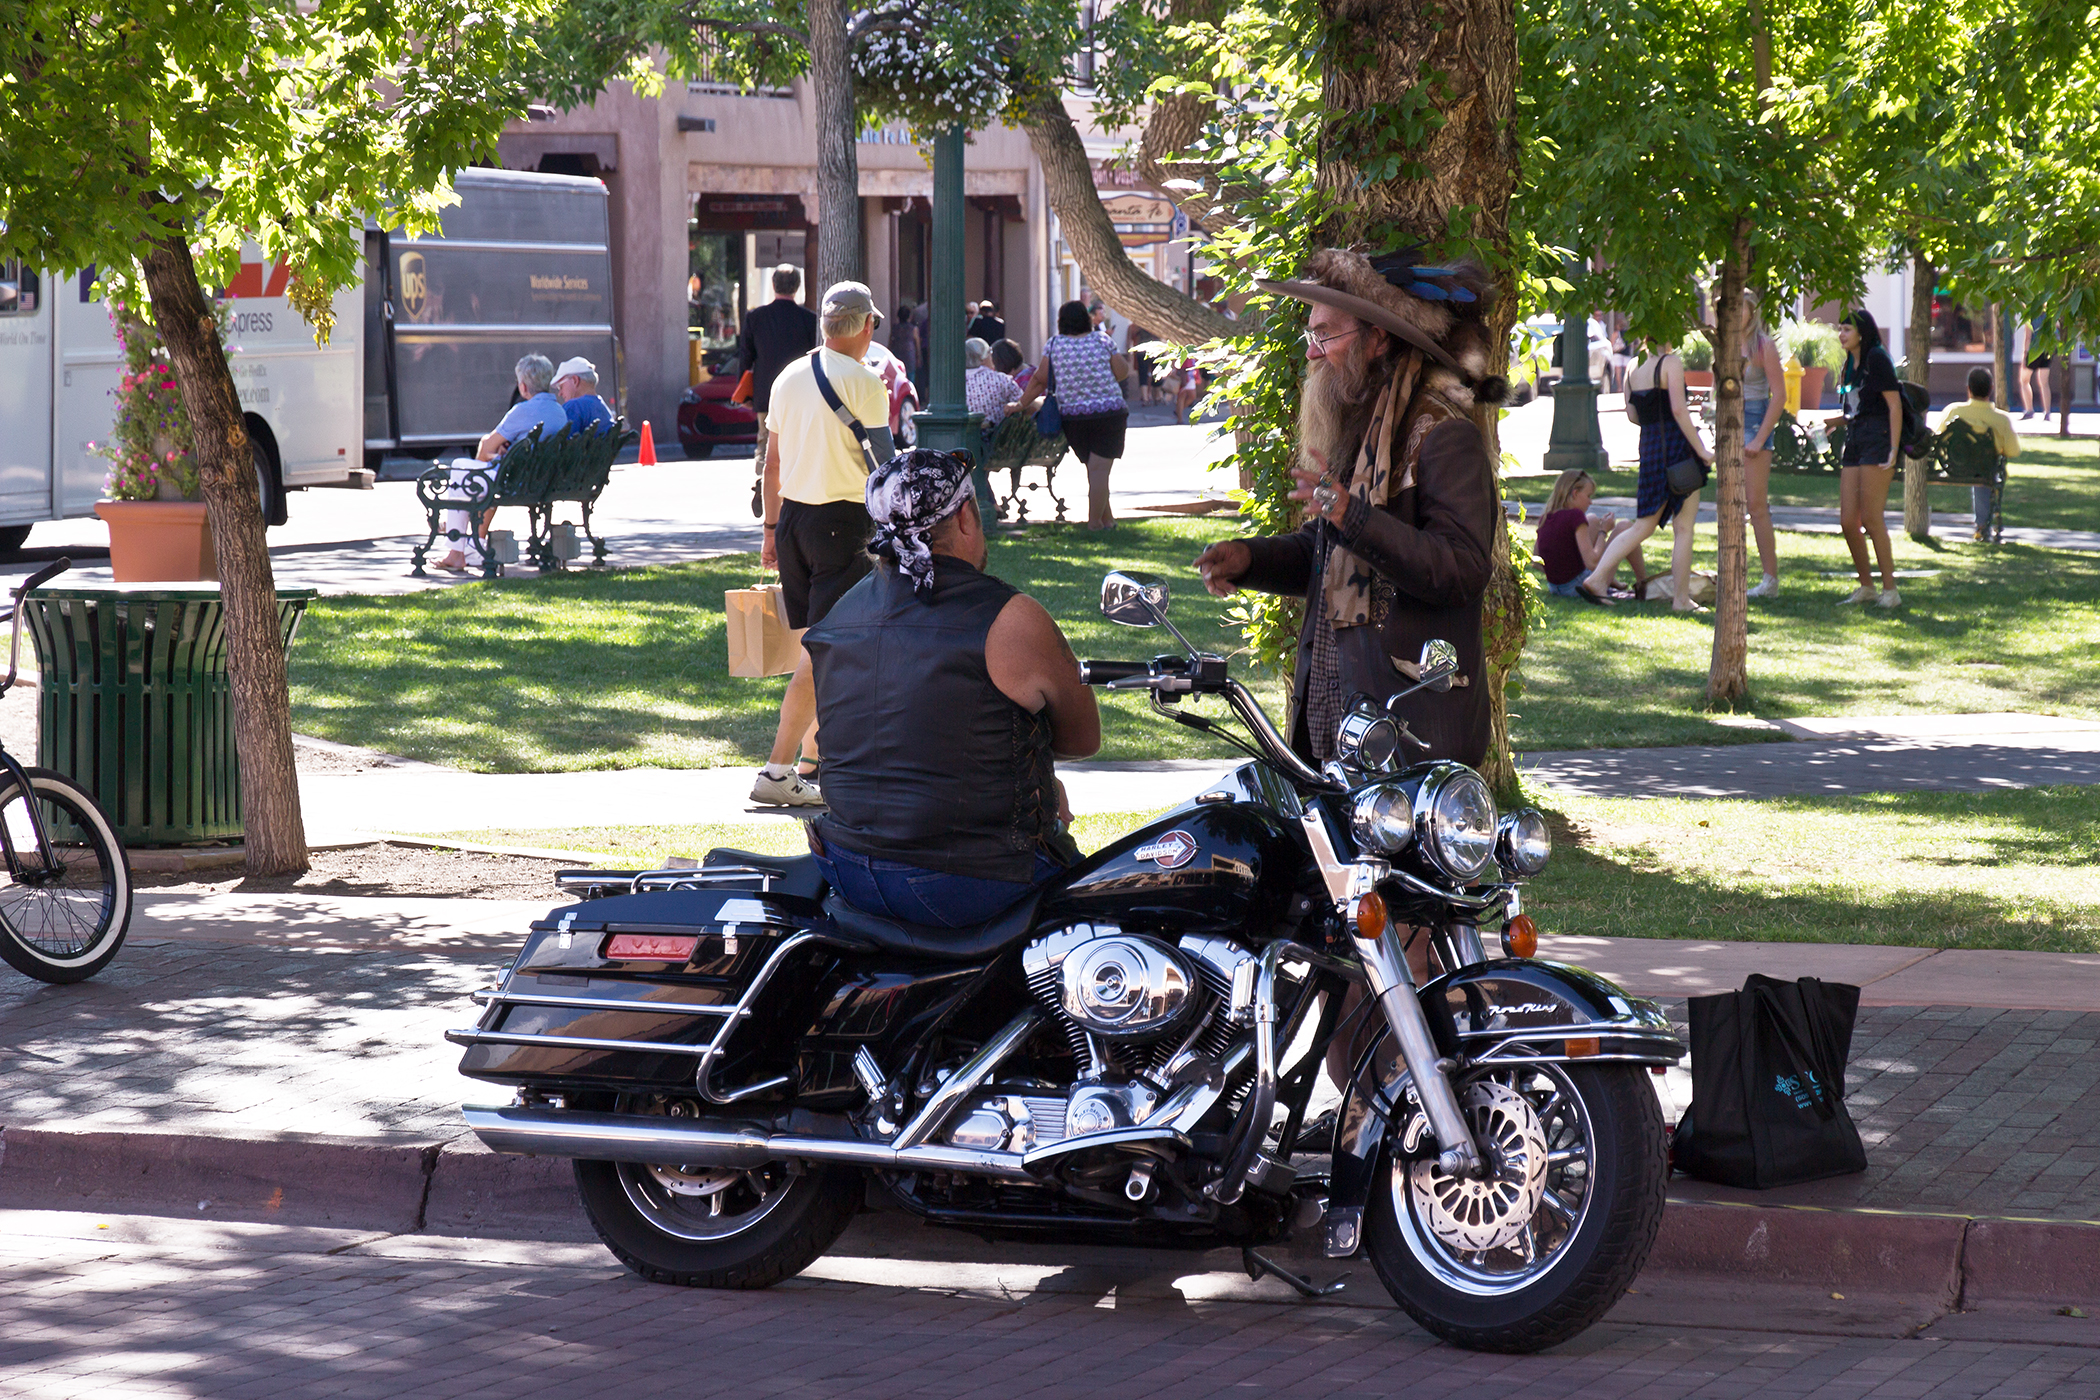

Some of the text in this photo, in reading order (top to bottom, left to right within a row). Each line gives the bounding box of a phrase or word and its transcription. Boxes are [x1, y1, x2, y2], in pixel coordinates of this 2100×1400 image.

[855, 129, 880, 144] nta
[882, 127, 896, 145] Fe
[1147, 201, 1163, 219] Fe
[529, 274, 589, 290] Worldwide Services
[225, 312, 274, 339] xpress
[1140, 848, 1178, 859] DAVIDSON
